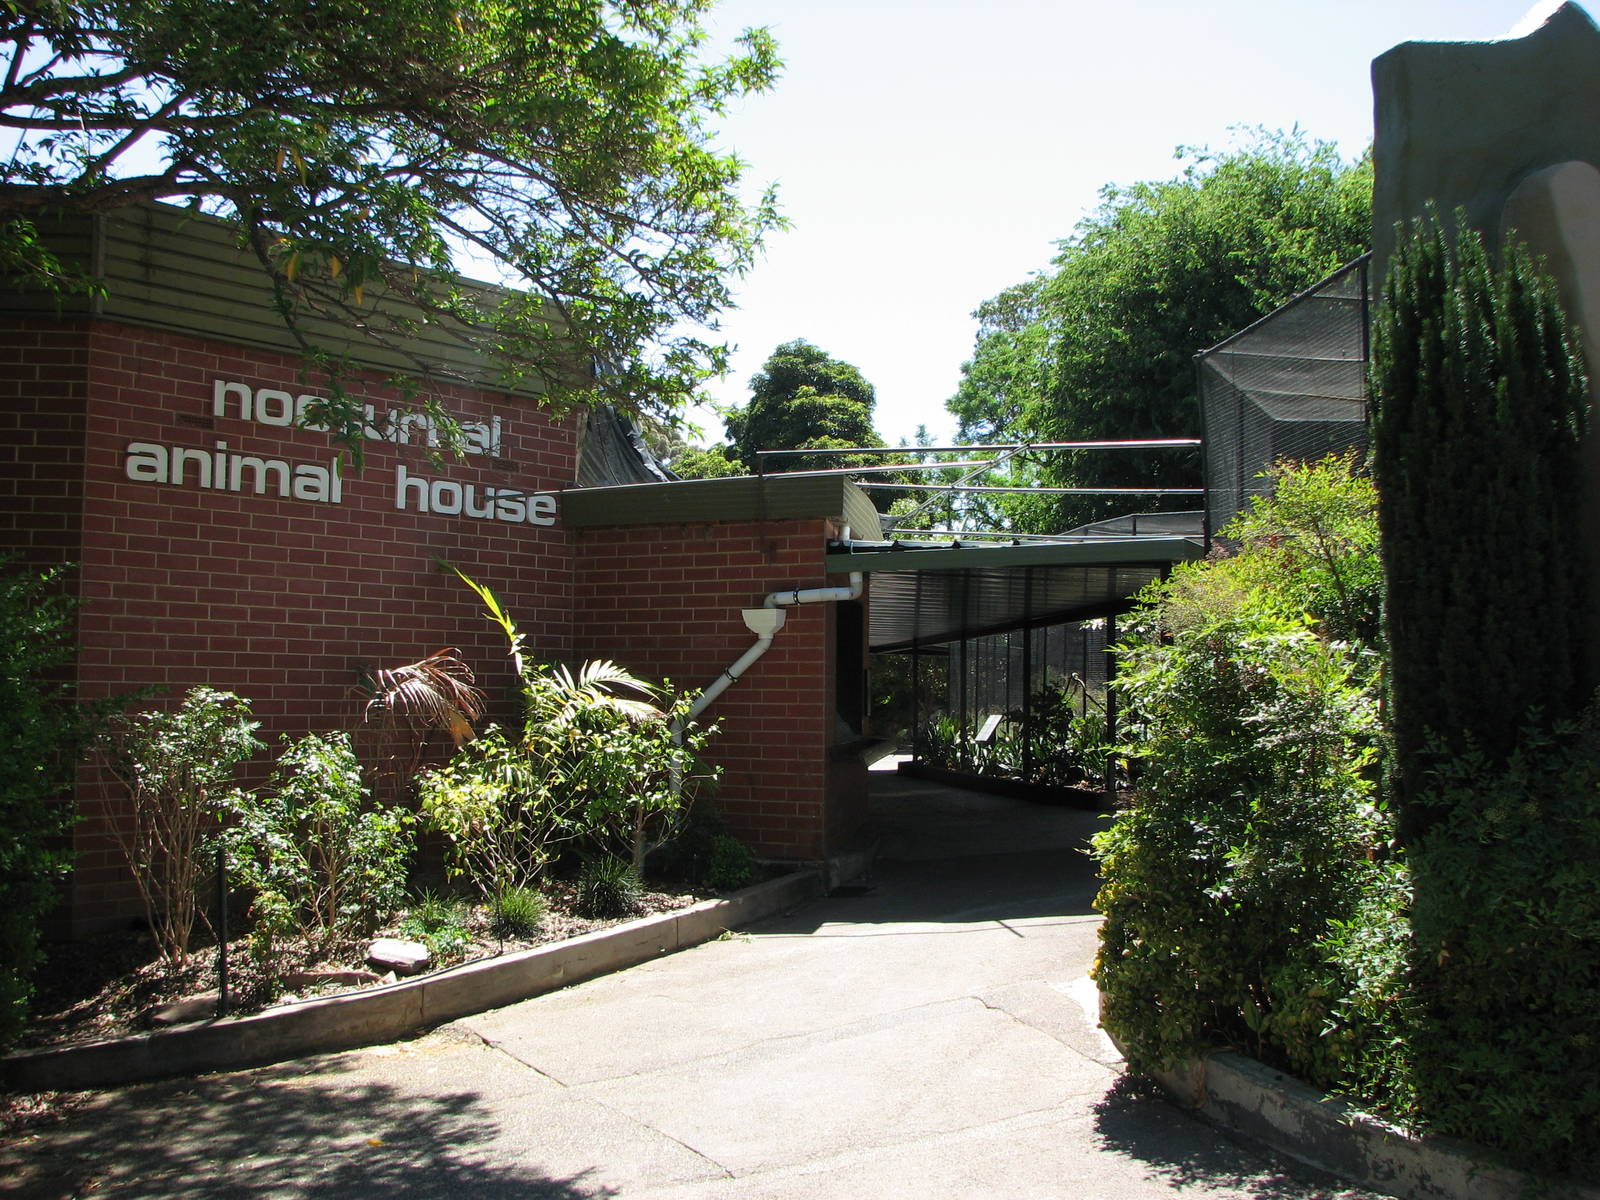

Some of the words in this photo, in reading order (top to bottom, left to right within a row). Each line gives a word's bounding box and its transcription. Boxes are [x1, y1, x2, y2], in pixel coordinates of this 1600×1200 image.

[214, 379, 501, 458] nocurnal
[126, 440, 342, 504] animal
[396, 464, 557, 526] house
